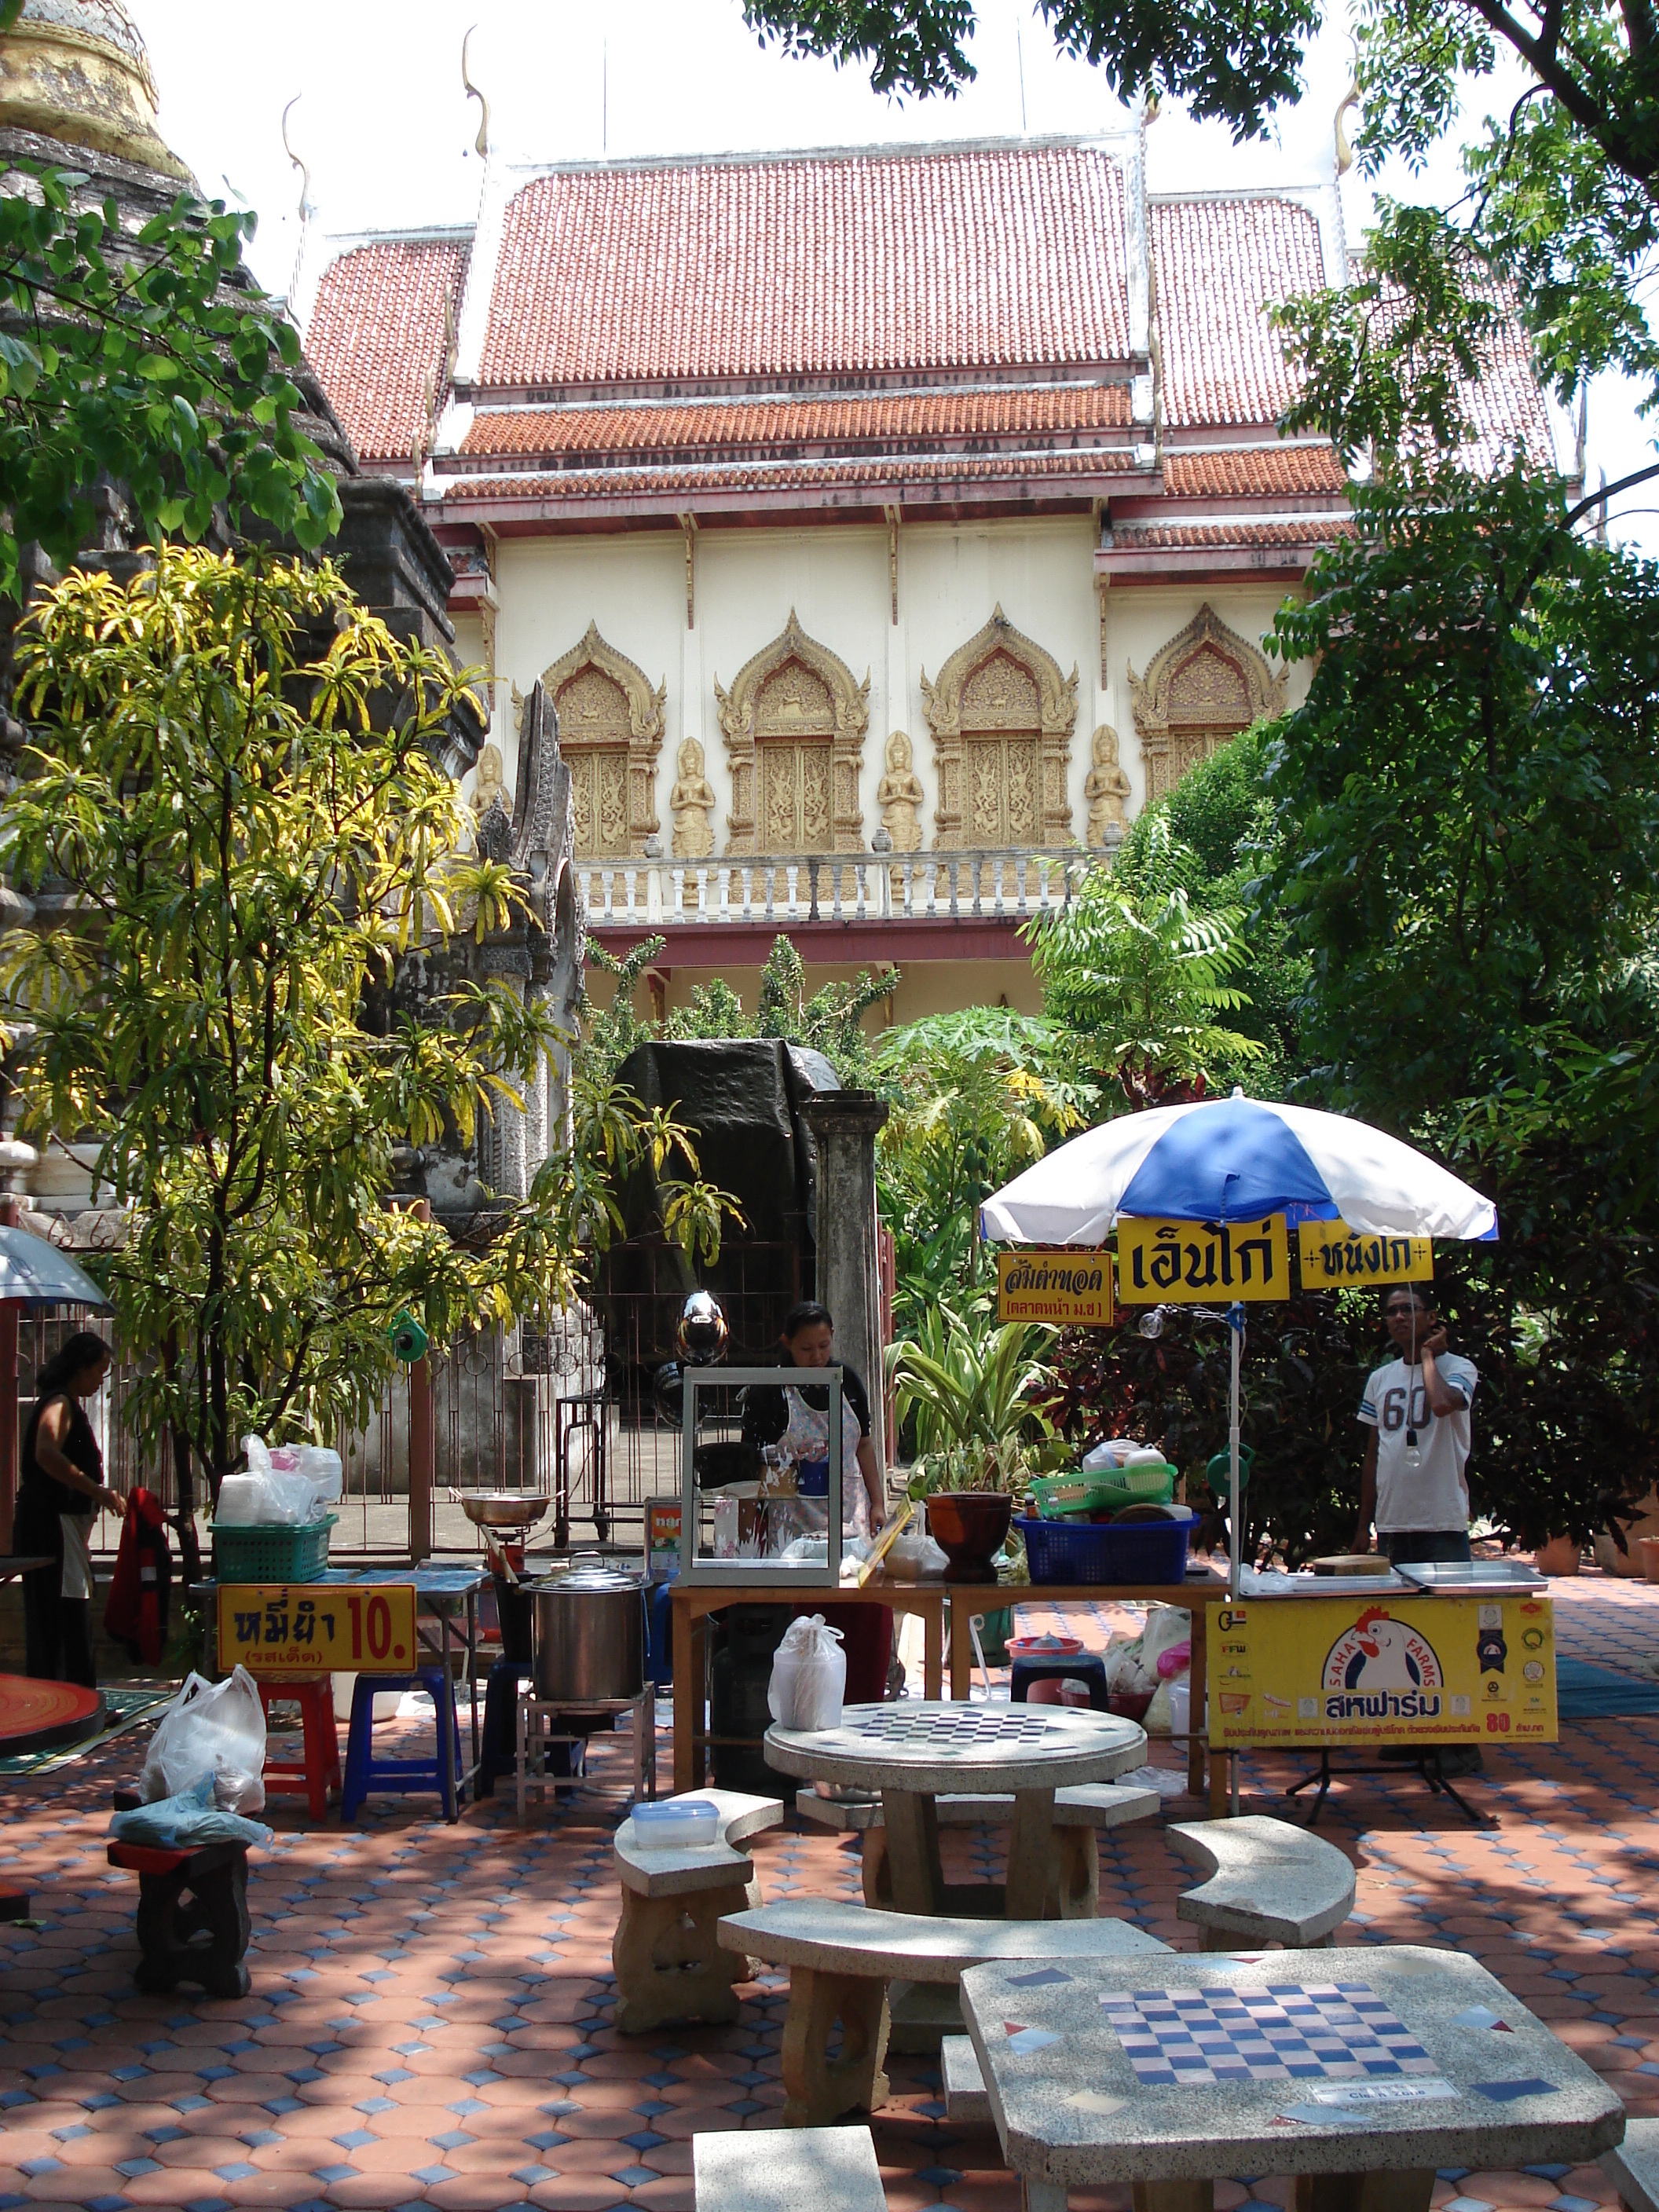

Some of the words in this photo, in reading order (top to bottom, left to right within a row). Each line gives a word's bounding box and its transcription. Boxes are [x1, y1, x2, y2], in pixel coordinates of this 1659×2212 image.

[1132, 1220, 1273, 1289] เอ็นไก่
[1006, 1297, 1069, 1316] (ตลาดหน้า
[1382, 1386, 1432, 1431] 60
[233, 1588, 336, 1646] หมี่ยำ
[347, 1595, 406, 1661] 10.
[244, 1646, 323, 1664] (รสเด็ด)
[1329, 1643, 1357, 1687] SAHA
[1406, 1638, 1436, 1687] FARMS
[1325, 1688, 1441, 1719] สหฟาร์ม
[1486, 1712, 1511, 1733] 80
